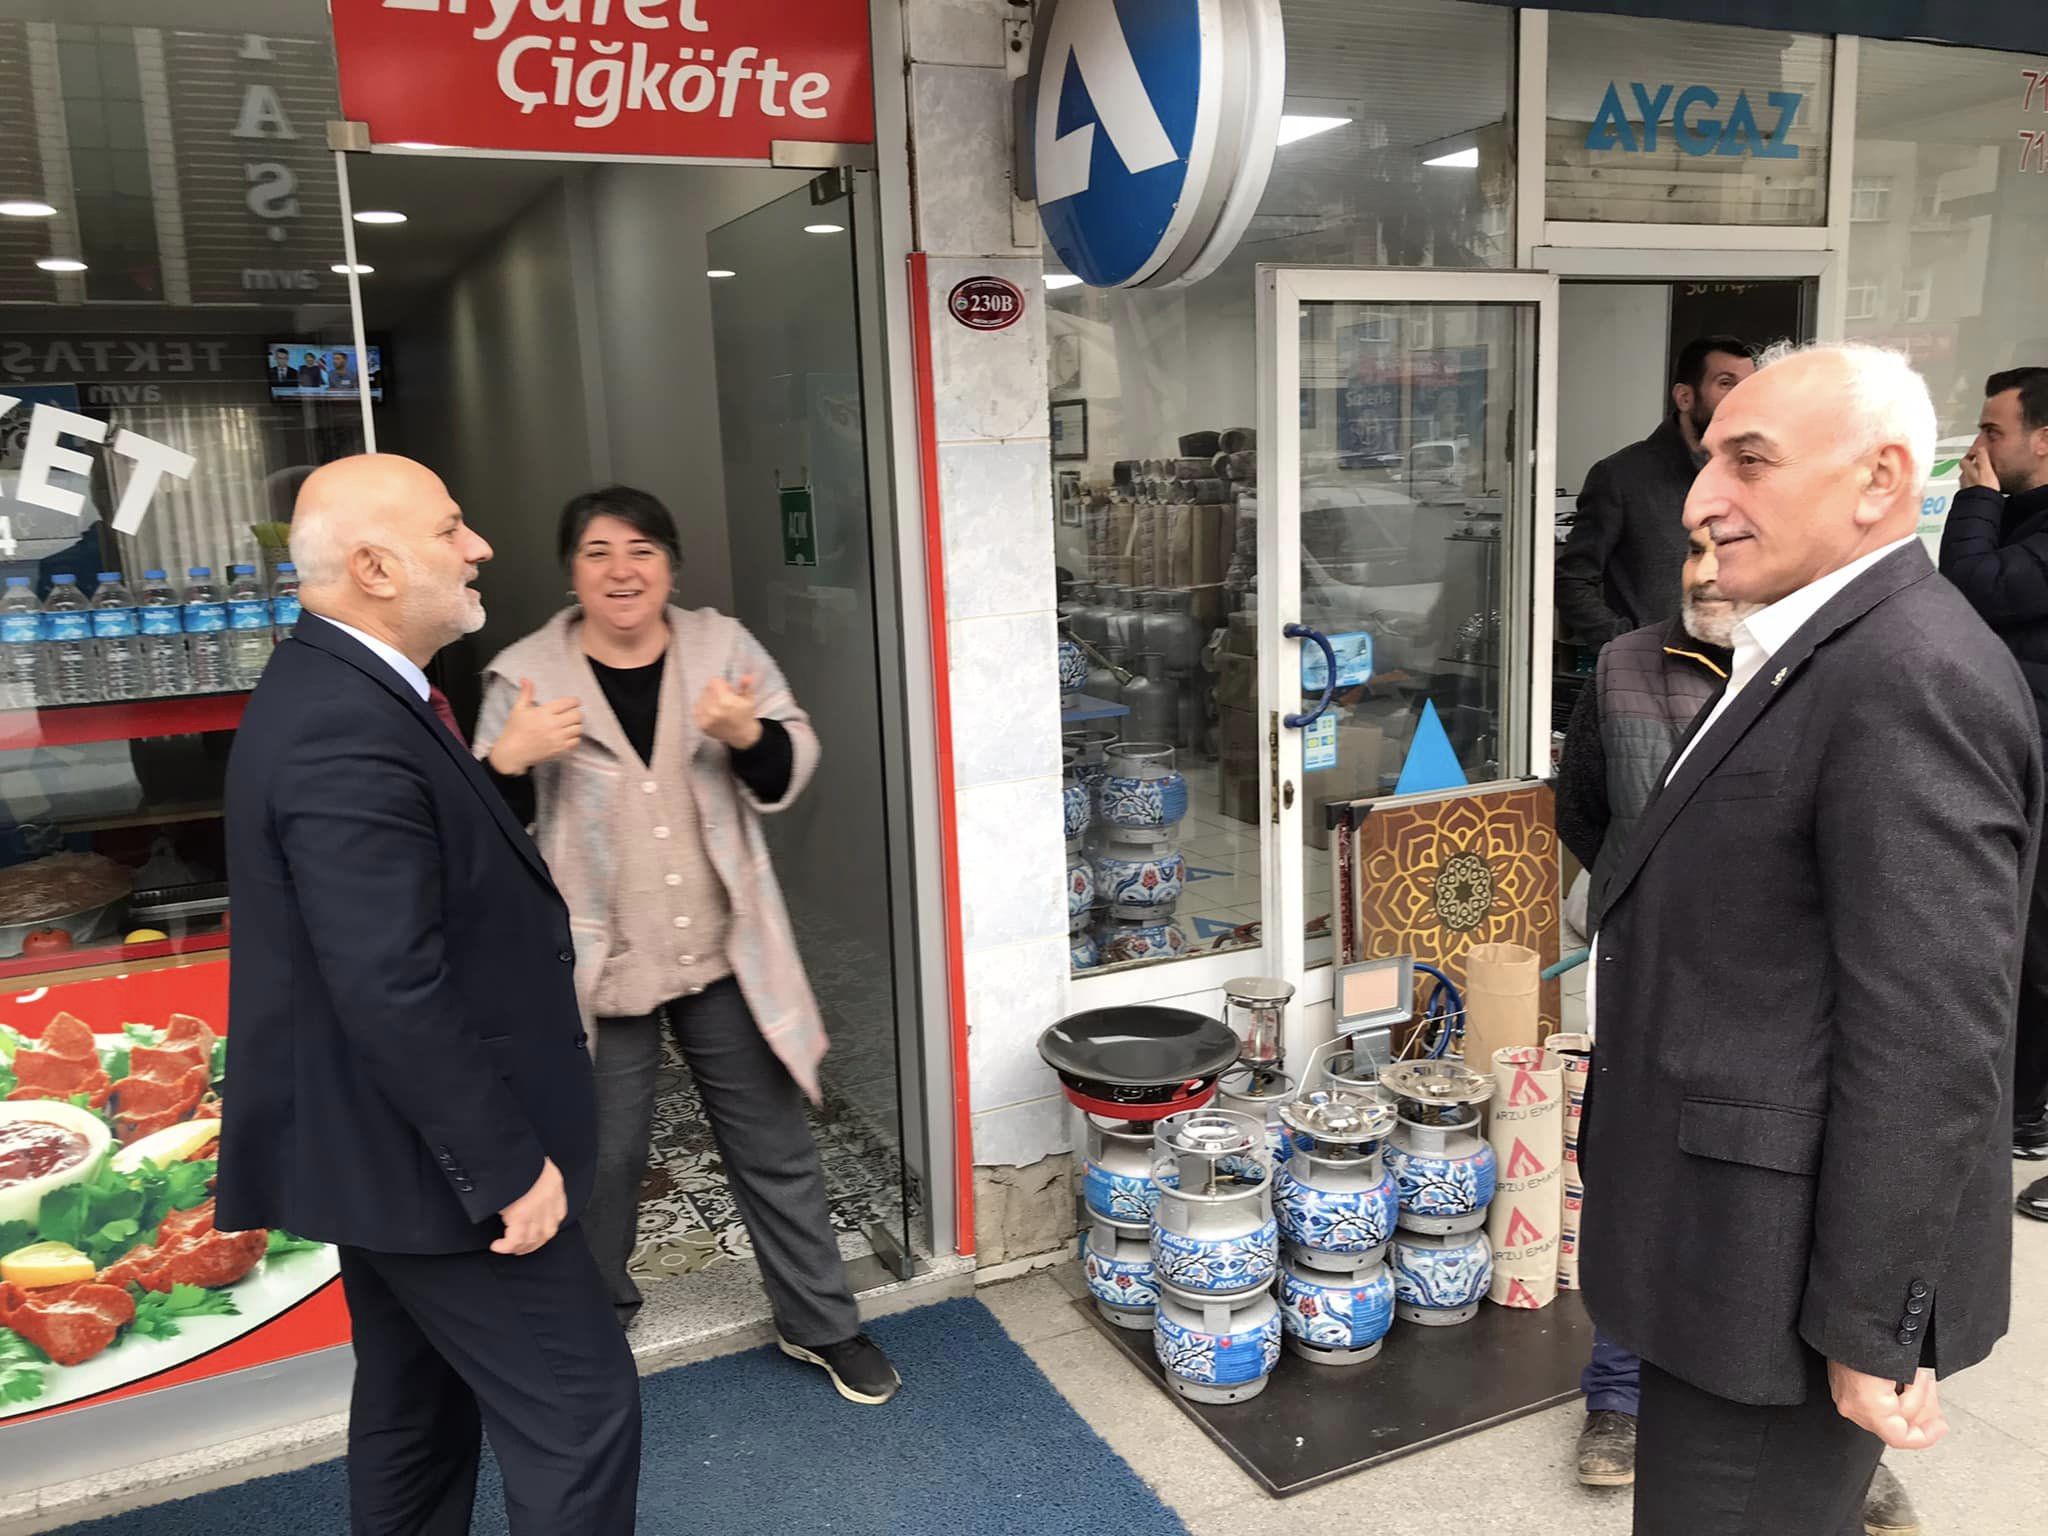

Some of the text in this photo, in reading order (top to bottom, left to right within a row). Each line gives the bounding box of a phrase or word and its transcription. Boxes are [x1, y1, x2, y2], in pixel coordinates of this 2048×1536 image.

[496, 35, 831, 129] Çiğköfte
[1584, 79, 1804, 160] AYGAZ
[970, 295, 1013, 312] 230B
